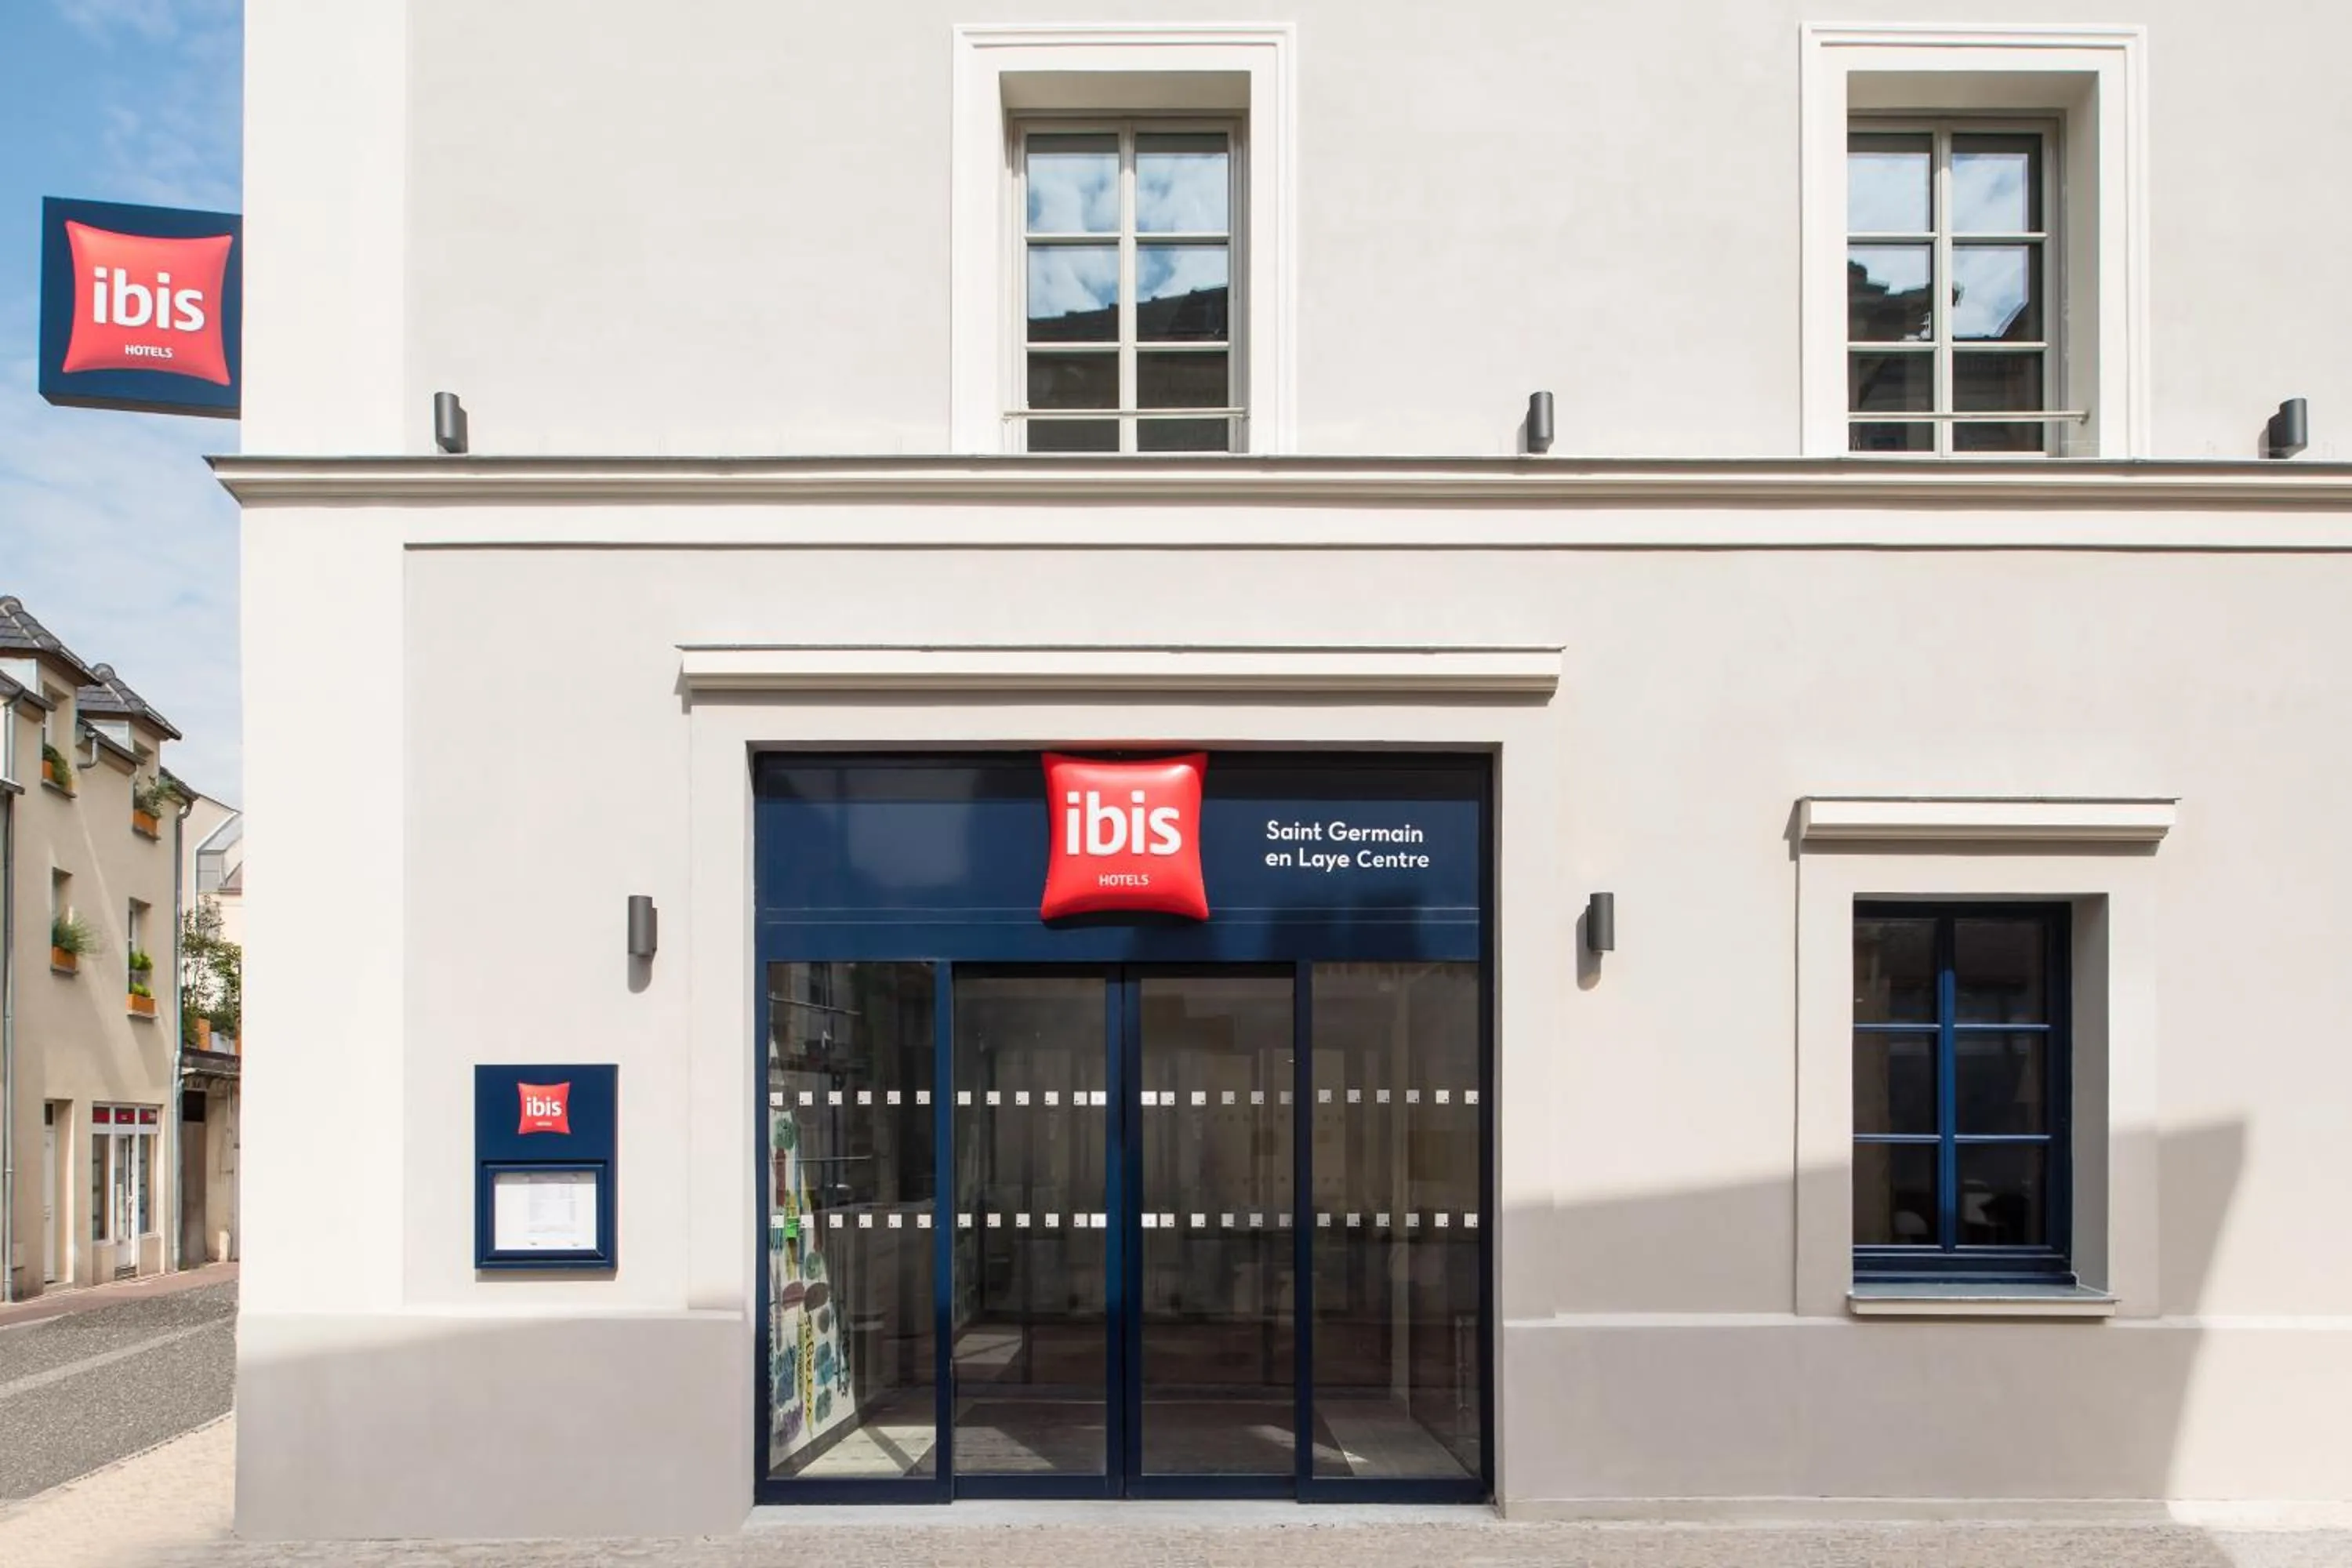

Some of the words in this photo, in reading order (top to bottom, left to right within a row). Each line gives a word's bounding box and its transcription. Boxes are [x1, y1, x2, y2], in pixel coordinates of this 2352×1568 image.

[93, 267, 205, 332] ibis
[125, 344, 172, 358] HOTELS
[1066, 790, 1182, 856] ibis
[1266, 819, 1323, 841] Saint
[1328, 821, 1424, 843] Germain
[1265, 852, 1292, 866] en
[1298, 847, 1351, 873] Laye
[1356, 850, 1430, 868] Centre
[1098, 873, 1149, 886] HOTELS
[526, 1096, 563, 1117] ibis
